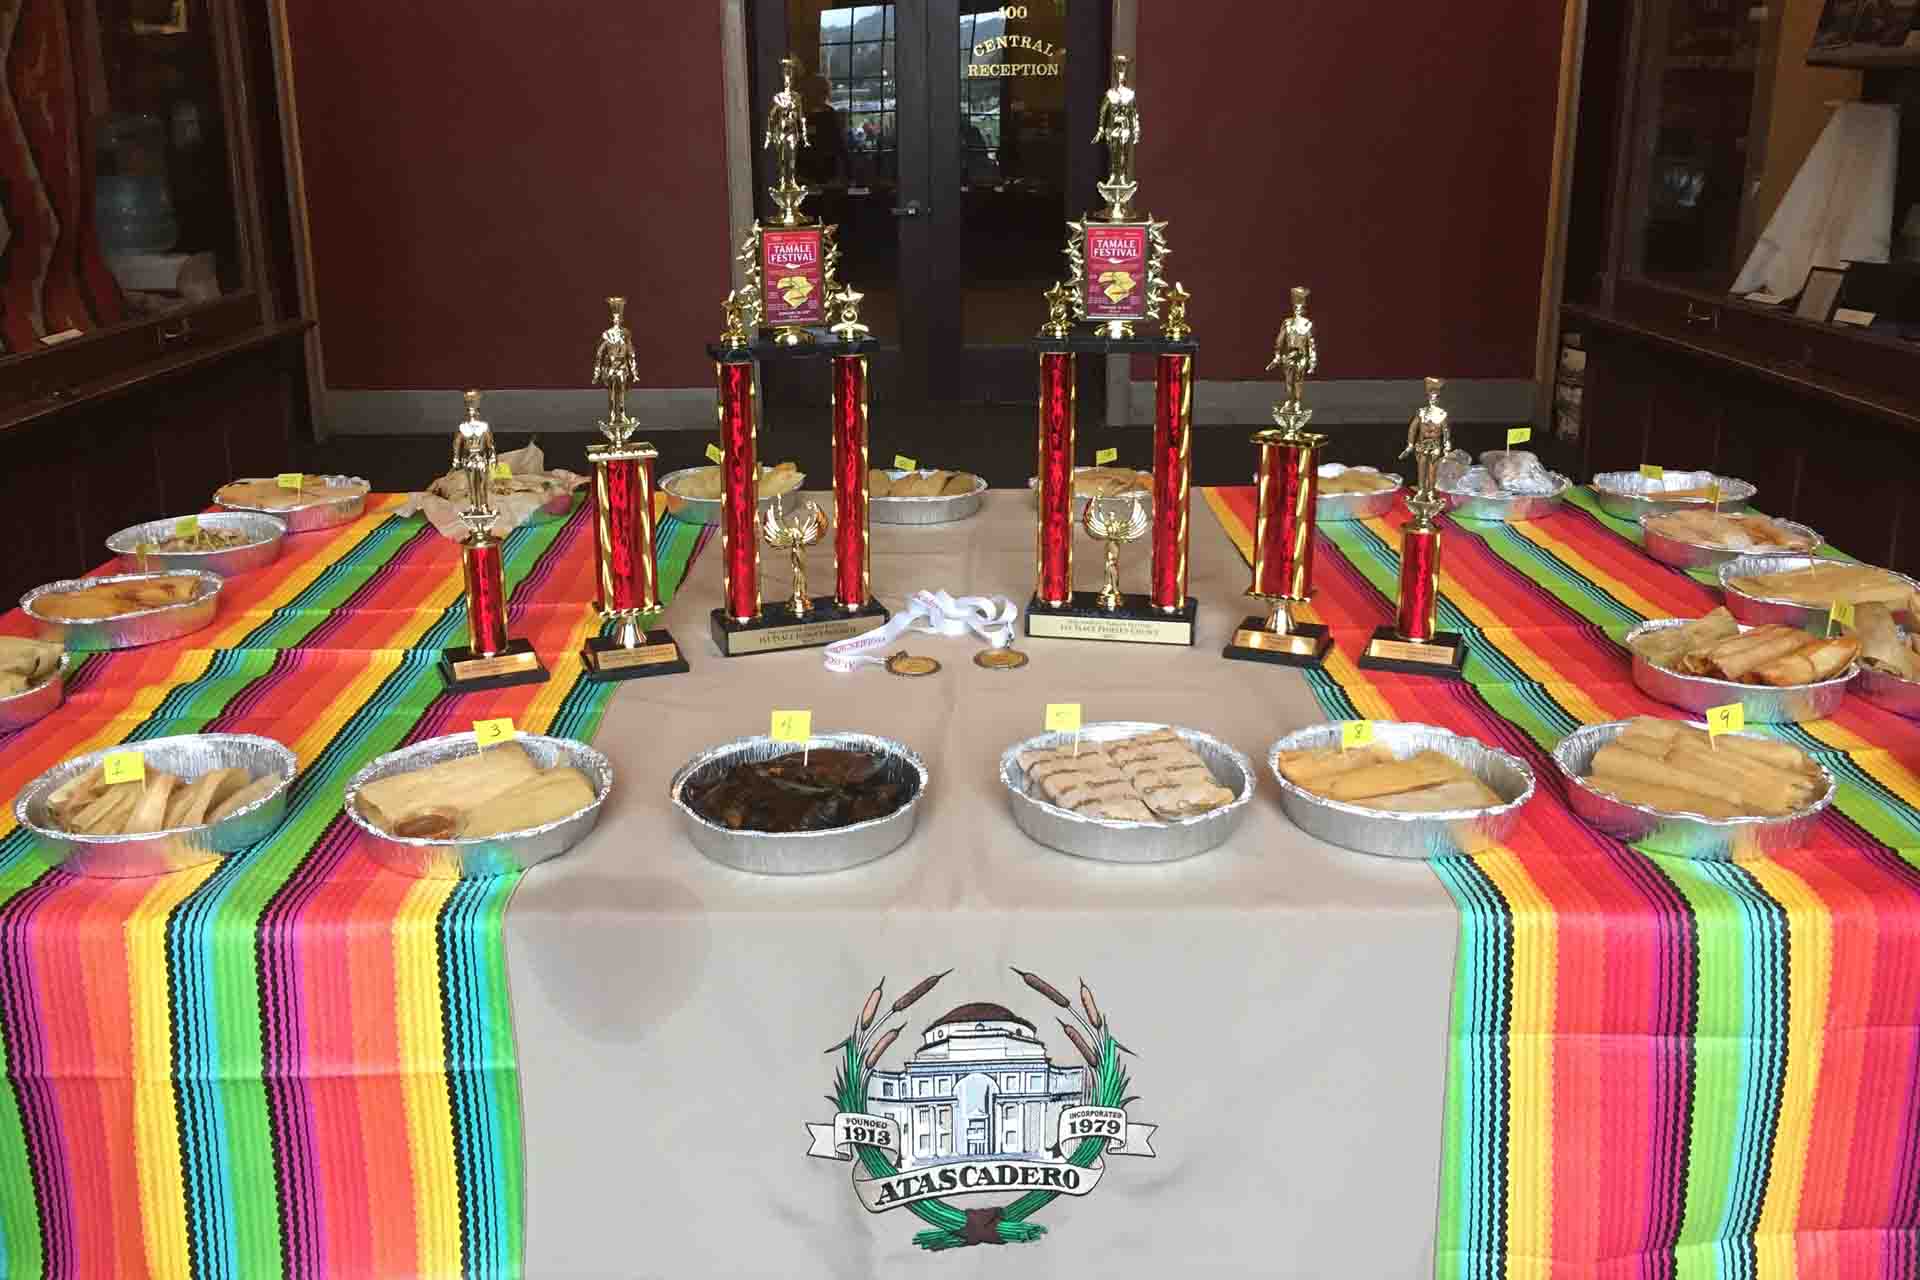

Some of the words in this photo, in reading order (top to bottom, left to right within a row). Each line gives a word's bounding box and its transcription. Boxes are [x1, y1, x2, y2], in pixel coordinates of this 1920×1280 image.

[973, 35, 1054, 57] CENTRAL
[967, 63, 1058, 77] RECEPTION
[774, 244, 811, 253] TAMALE
[1096, 240, 1136, 249] TAMALE
[771, 252, 814, 263] FESTIVAL
[1093, 248, 1137, 257] FESTIVAL
[1719, 708, 1730, 729] 9
[490, 723, 502, 737] 3
[1069, 1110, 1122, 1119] INCORPORATED
[845, 1117, 888, 1129] FOUNDED
[1068, 1118, 1121, 1135] 1979
[844, 1126, 892, 1146] 1913
[874, 1164, 1080, 1206] ATASCADERO
